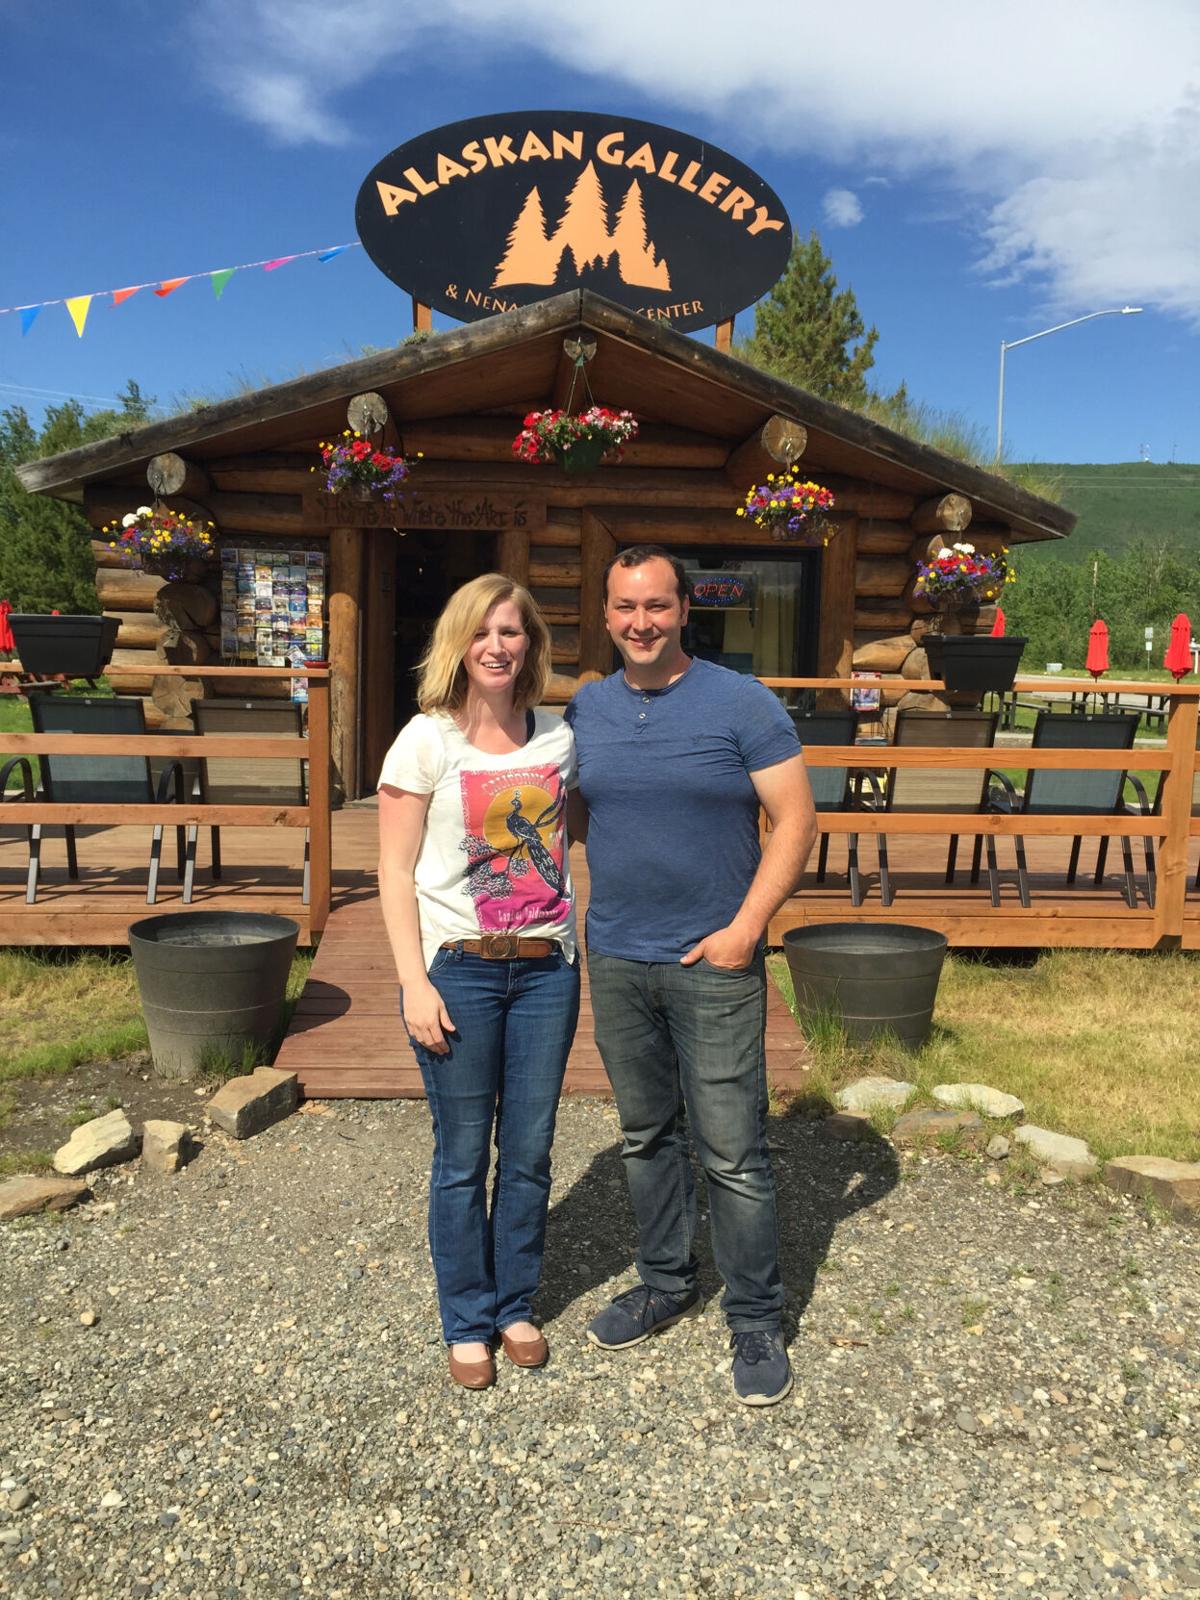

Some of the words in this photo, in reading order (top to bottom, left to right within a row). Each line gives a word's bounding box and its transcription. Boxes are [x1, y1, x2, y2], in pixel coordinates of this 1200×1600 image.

[376, 130, 584, 217] ALASKAN
[597, 131, 784, 237] GALLERY
[445, 283, 459, 301] &
[465, 288, 520, 313] NENA
[693, 583, 744, 598] OPEN
